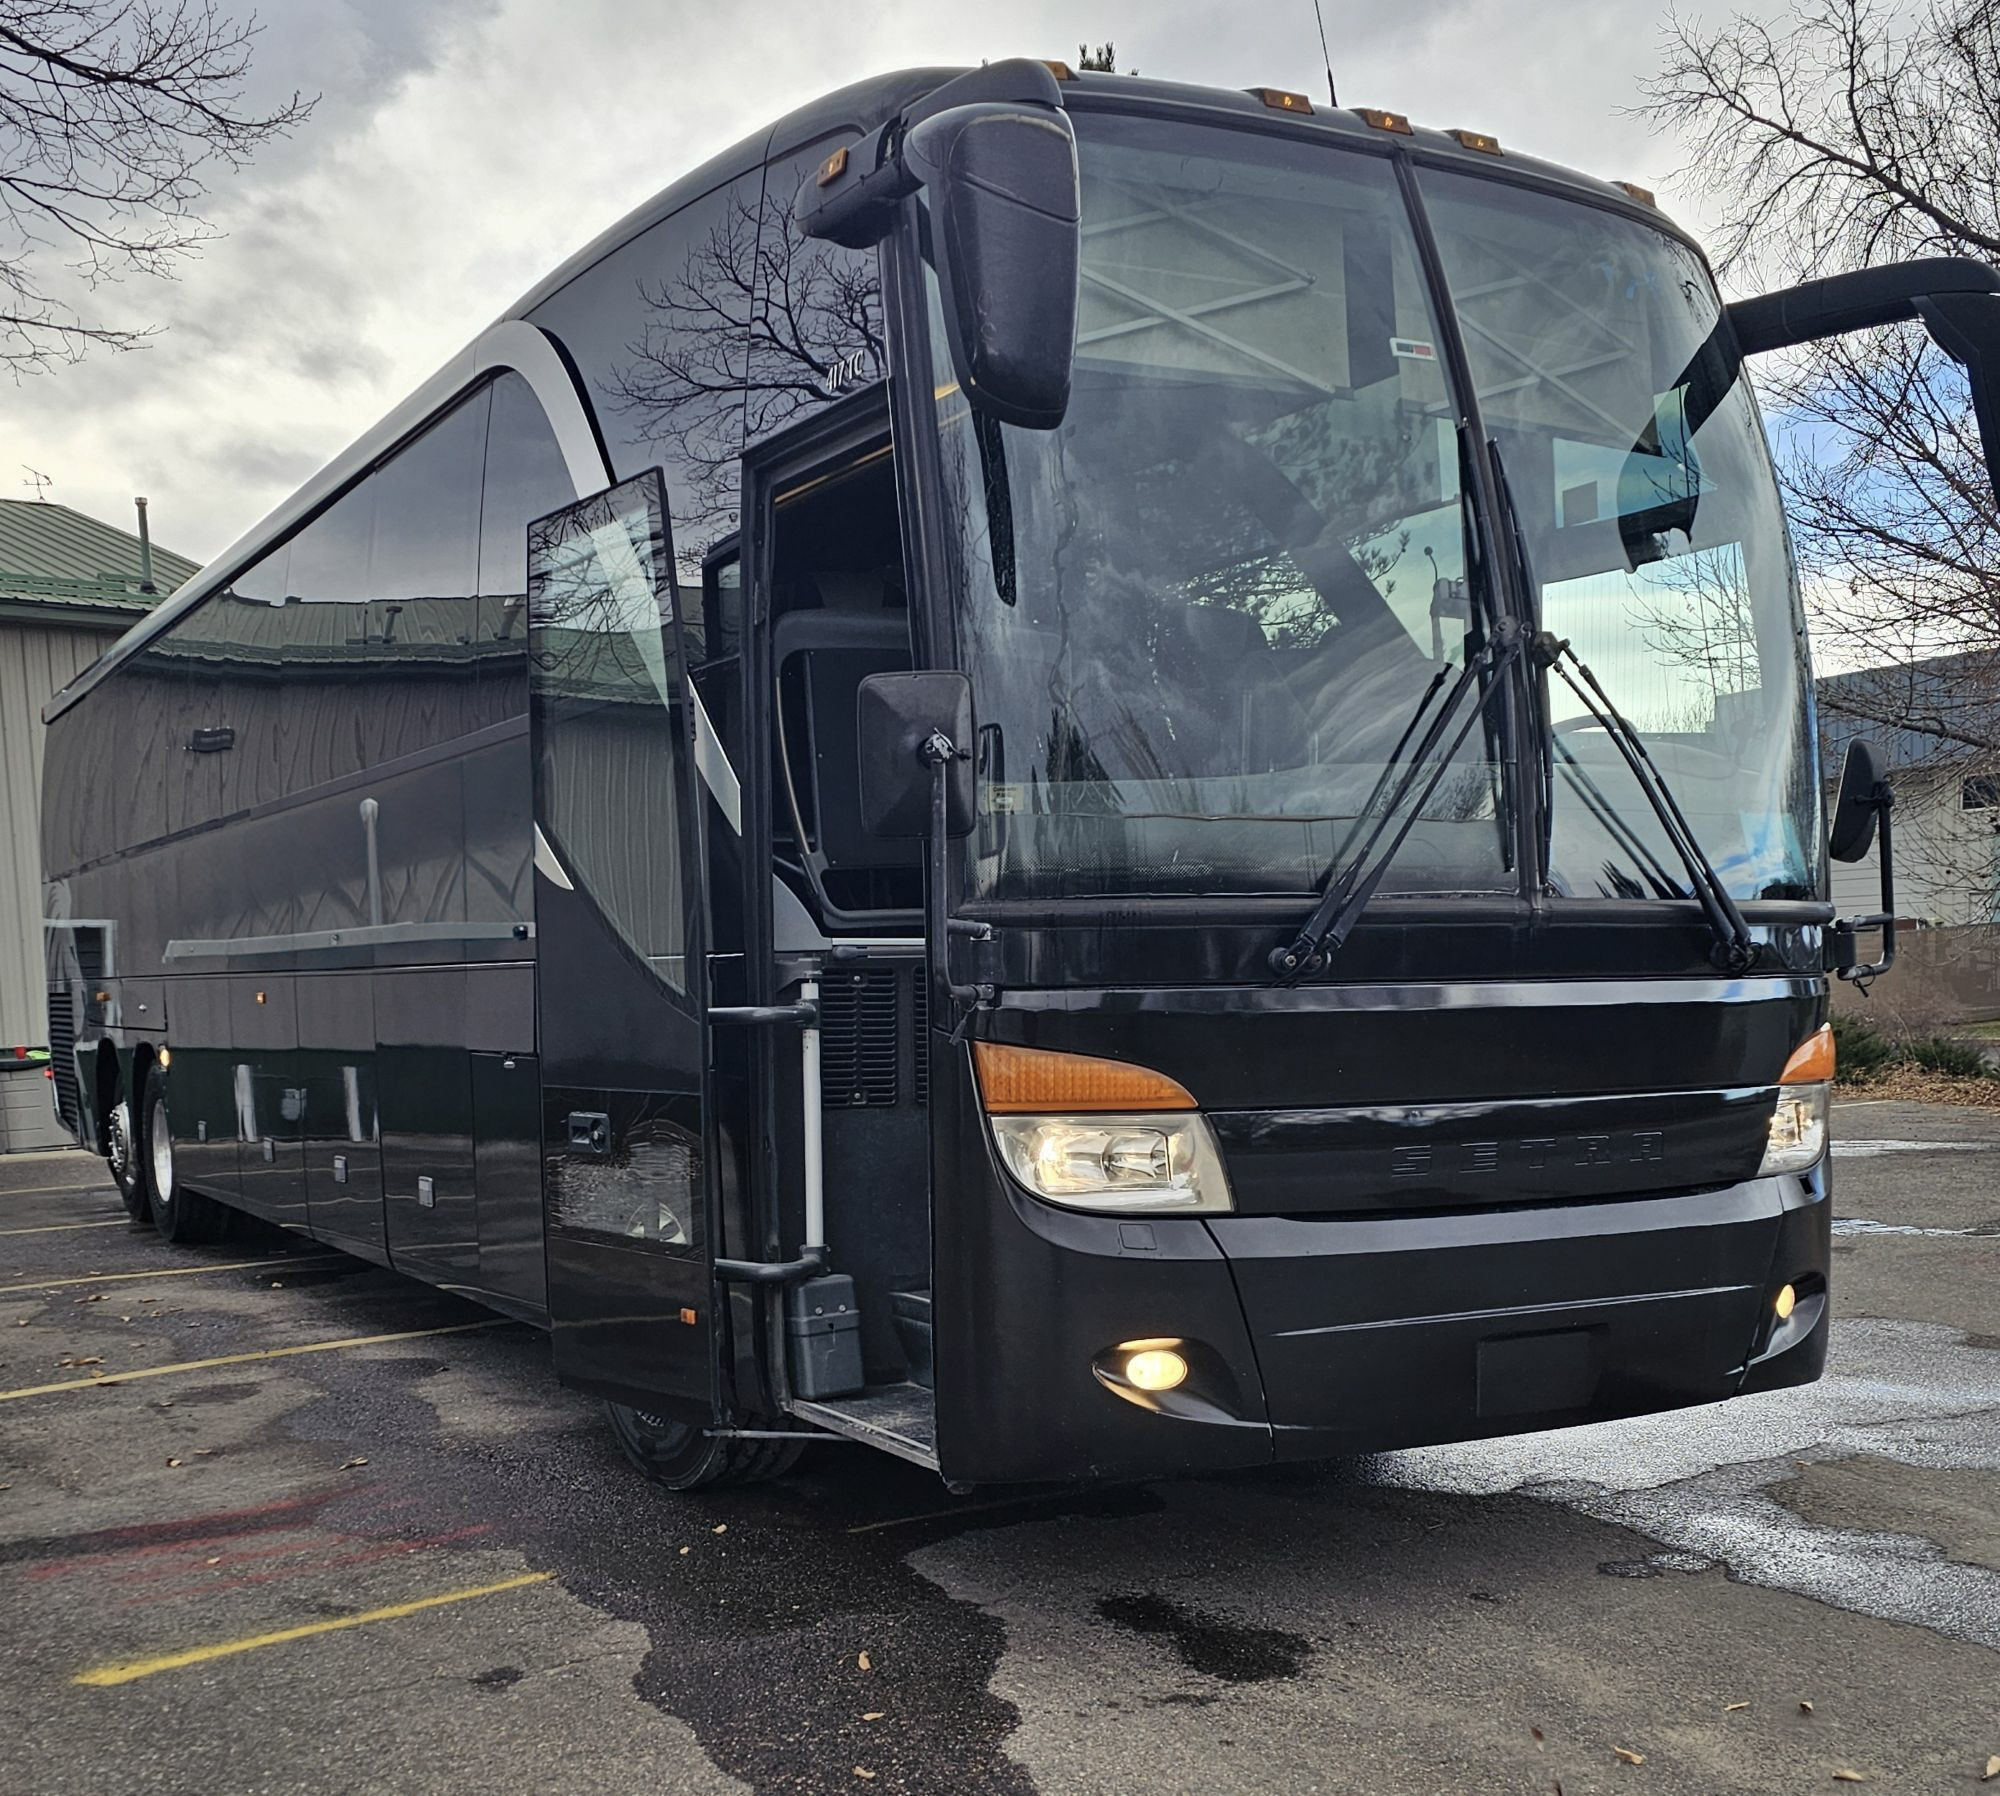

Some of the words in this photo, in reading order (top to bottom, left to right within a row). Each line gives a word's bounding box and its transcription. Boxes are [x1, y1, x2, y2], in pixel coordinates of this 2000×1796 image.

[826, 360, 845, 391] 417
[846, 350, 865, 380] TC
[1391, 1131, 1664, 1178] SETRA
